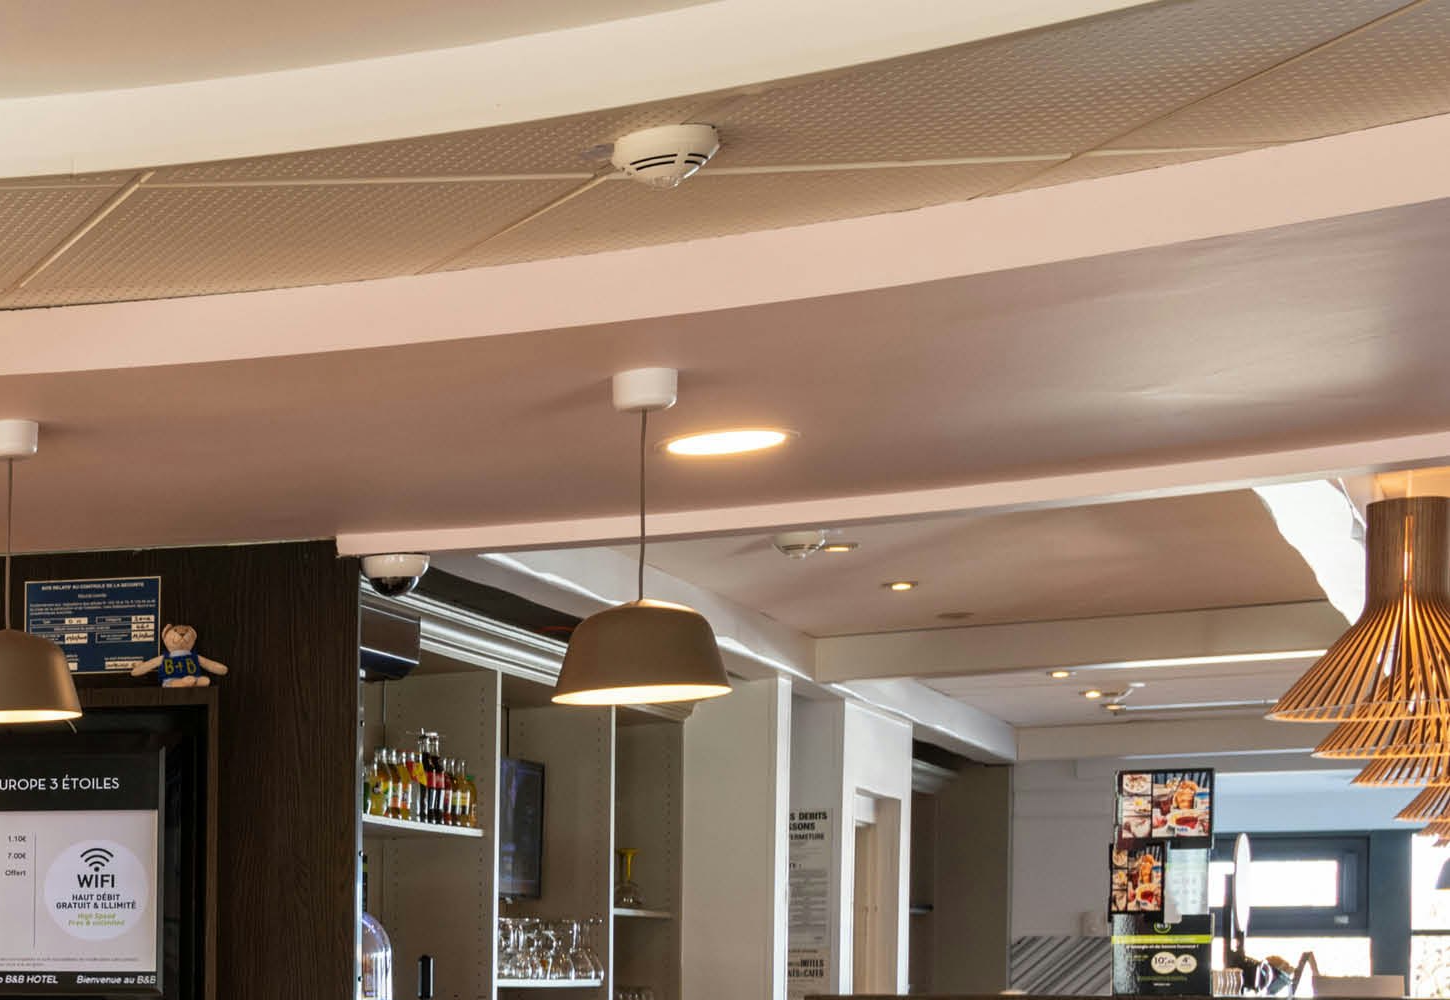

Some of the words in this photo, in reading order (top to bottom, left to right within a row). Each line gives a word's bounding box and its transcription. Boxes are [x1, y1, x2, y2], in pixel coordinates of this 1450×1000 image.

[49, 778, 59, 791] 3
[62, 774, 120, 790] ÉTOILES
[77, 874, 115, 888] WIFI
[96, 892, 120, 901] DÉBIT
[101, 900, 136, 909] ILLIMITÉ
[5, 975, 25, 984] B&B
[26, 975, 59, 984] HOTEL
[76, 975, 122, 984] Bienvenue
[136, 975, 156, 984] B&B
